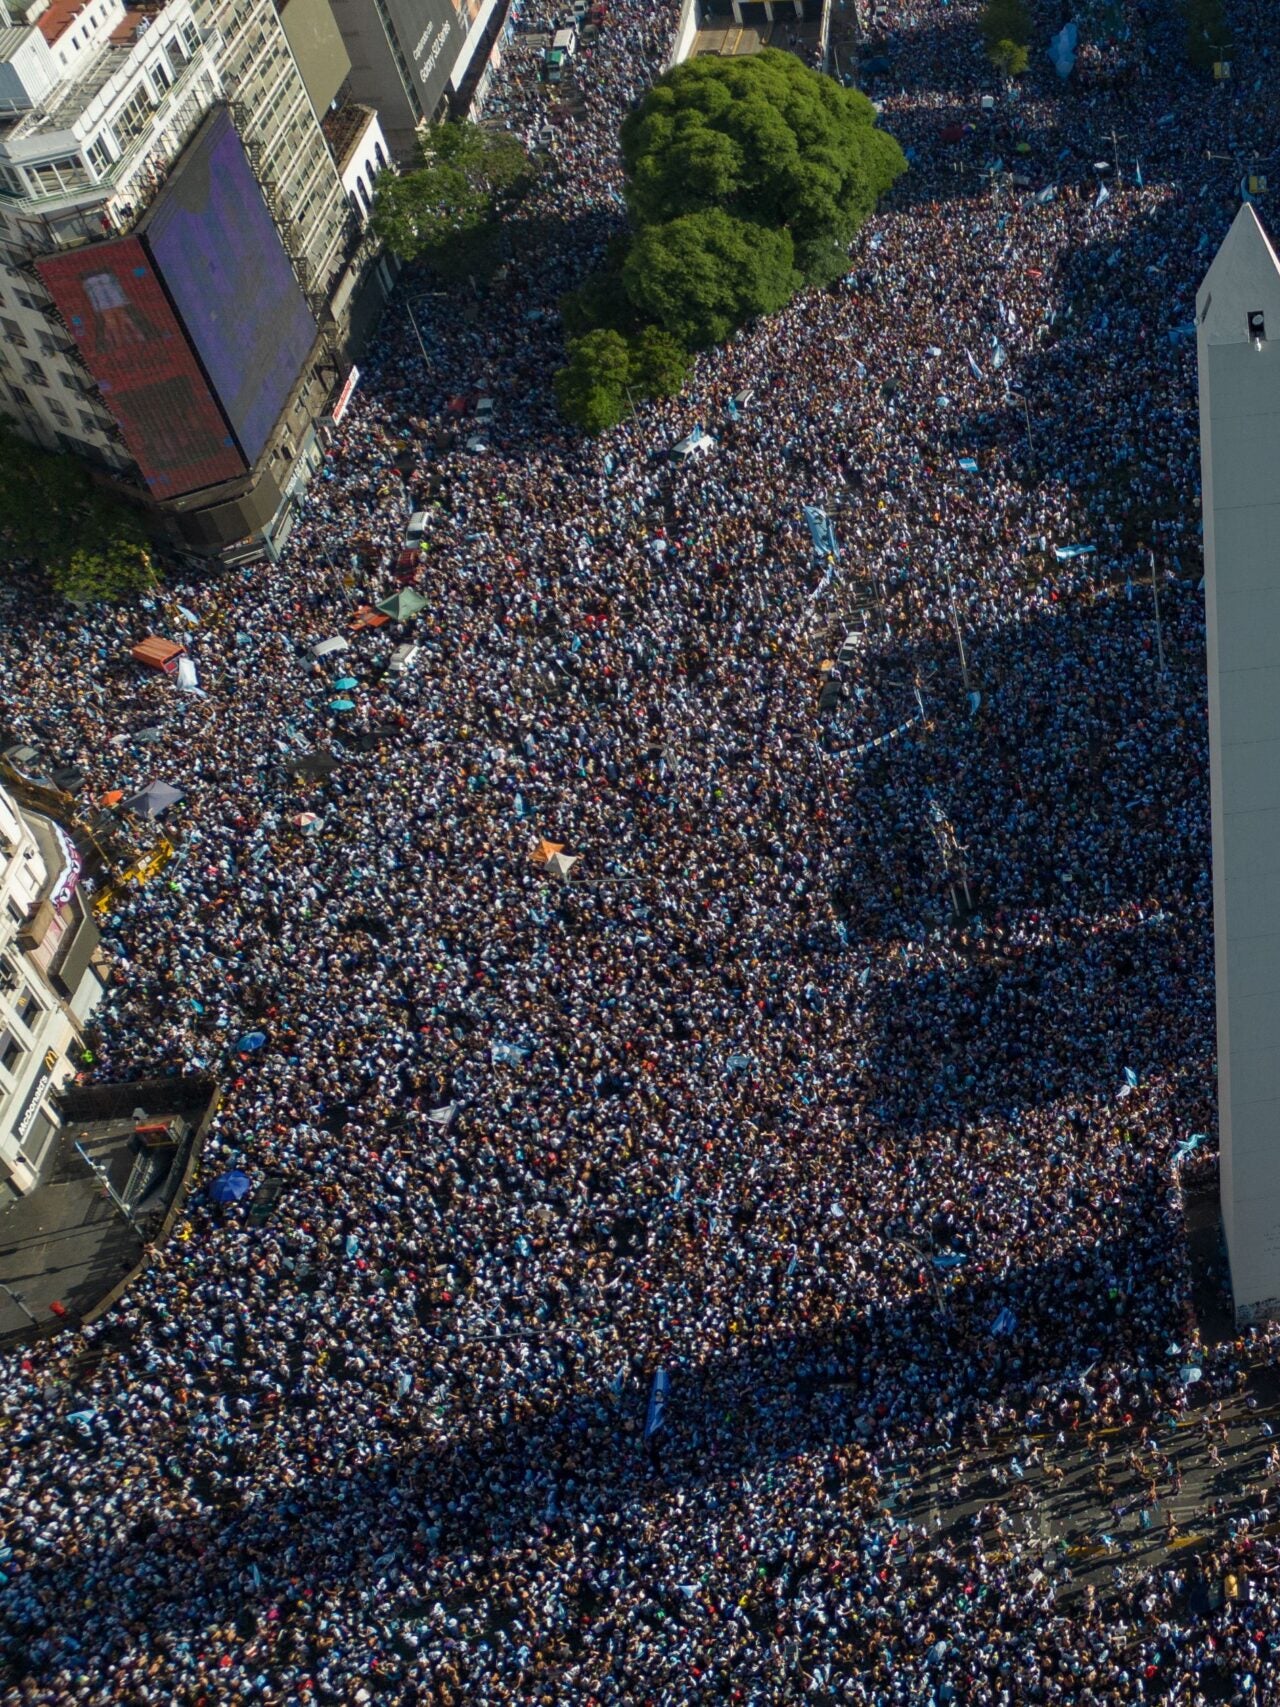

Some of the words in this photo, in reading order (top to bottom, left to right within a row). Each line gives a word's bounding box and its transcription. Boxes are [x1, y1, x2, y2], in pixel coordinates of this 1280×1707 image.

[420, 53, 436, 83] Galaxy
[438, 20, 451, 46] Series
[18, 1075, 48, 1136] McDonald's
